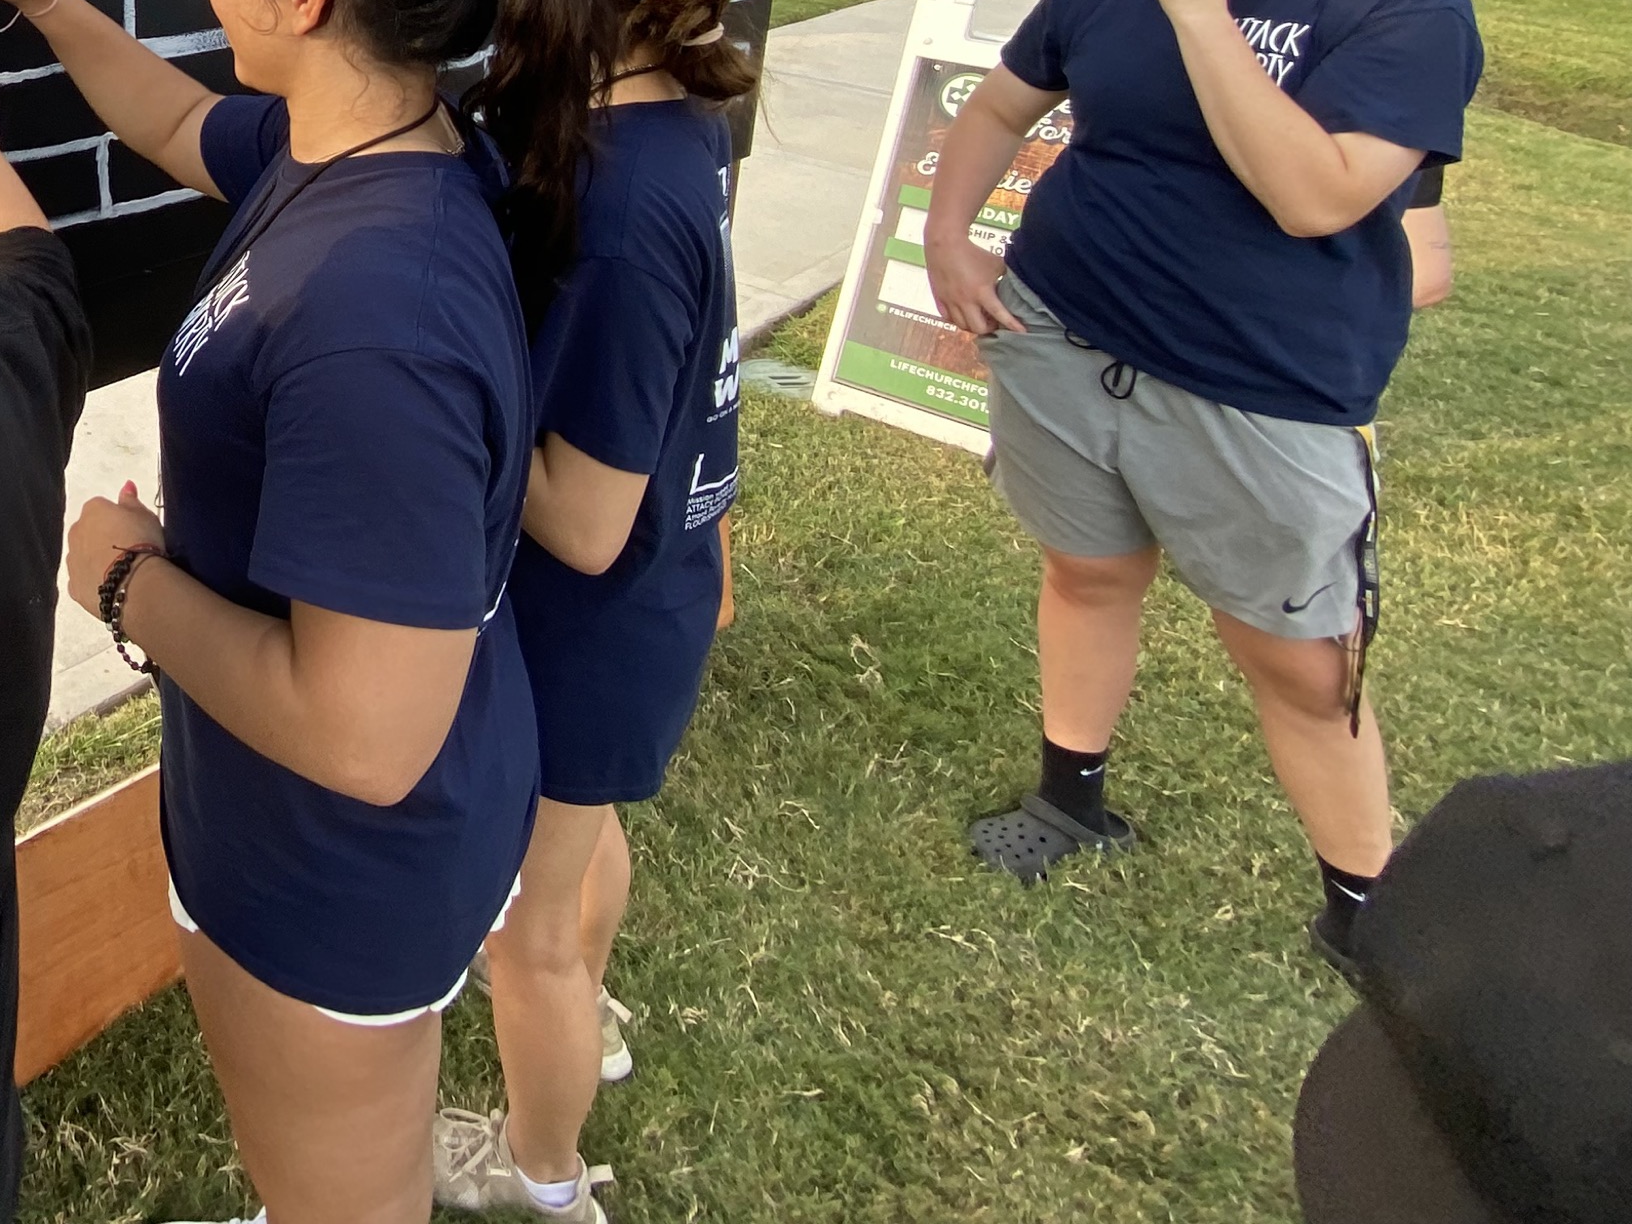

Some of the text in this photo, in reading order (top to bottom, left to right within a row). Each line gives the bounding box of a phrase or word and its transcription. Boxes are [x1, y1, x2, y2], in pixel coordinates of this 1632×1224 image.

[1234, 16, 1310, 57] TTACK
[978, 207, 1019, 225] DAY
[968, 227, 996, 240] SHIP
[890, 359, 989, 396] LIFECHURCHFO
[926, 385, 990, 414] 832.301.
